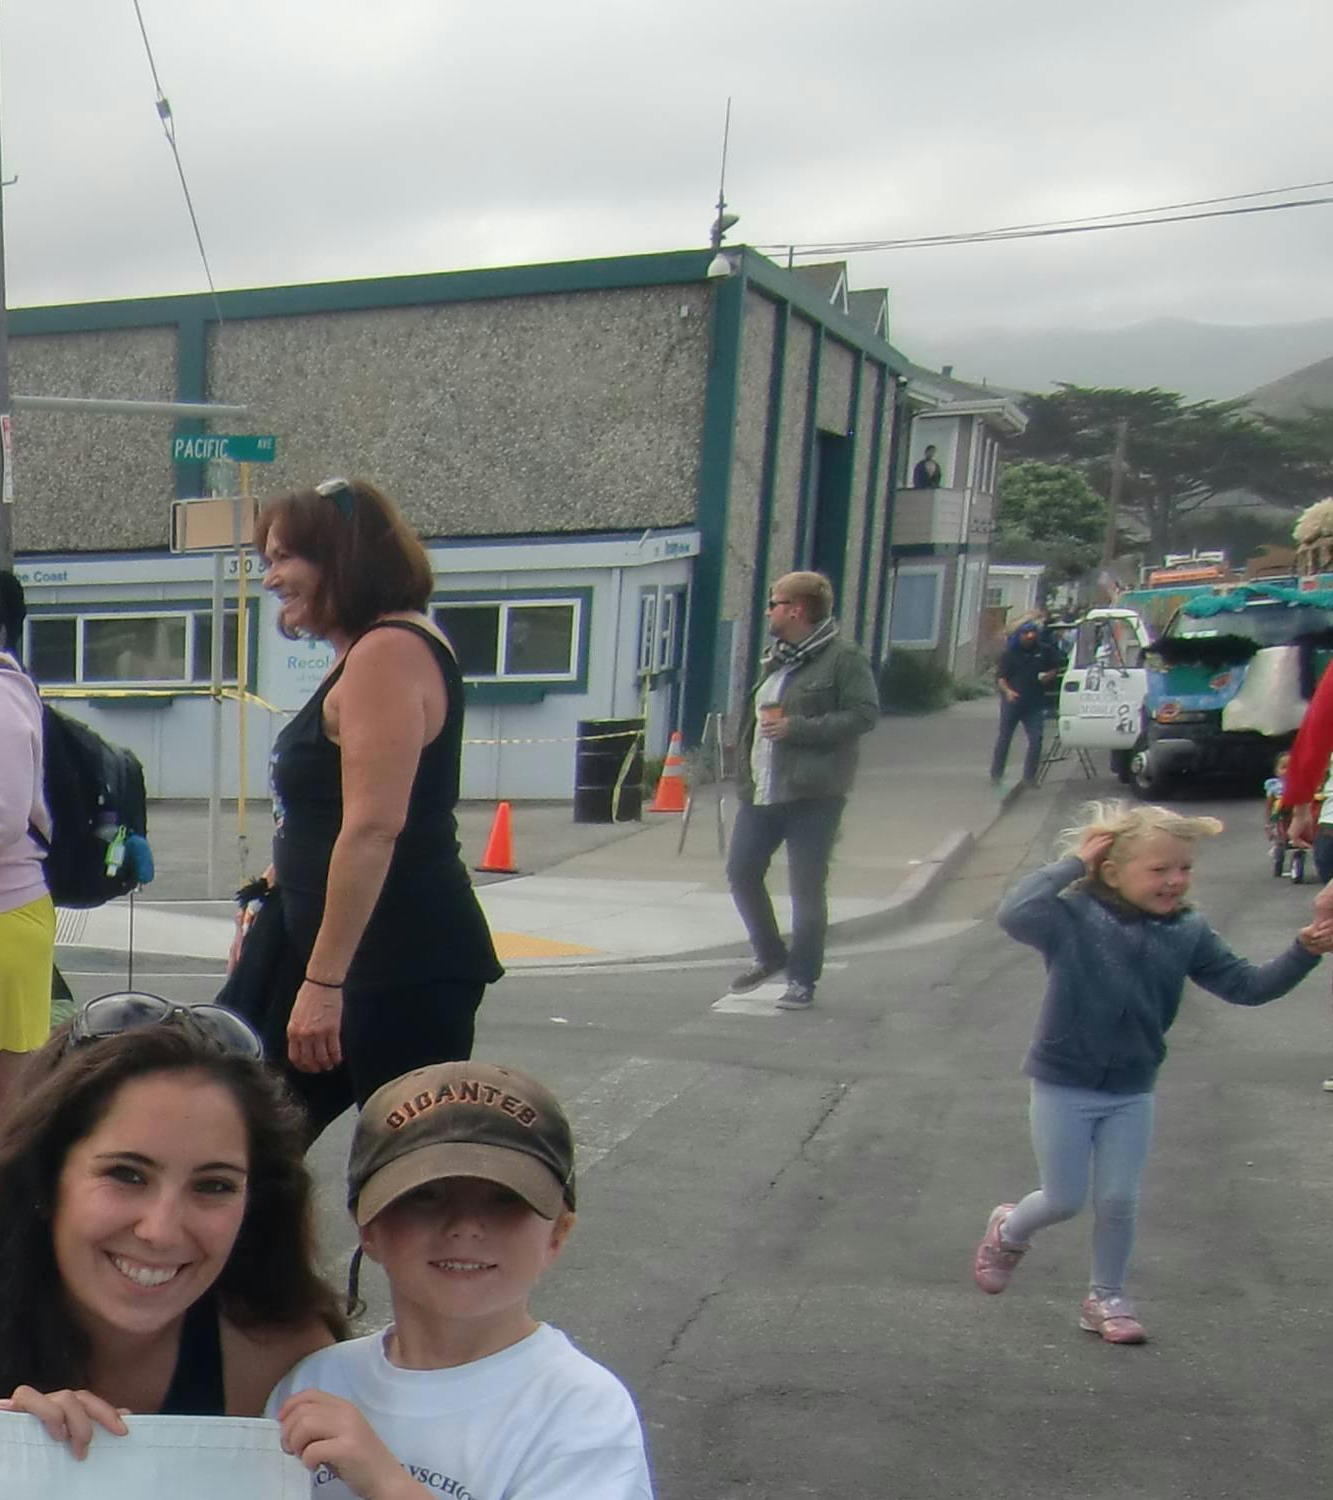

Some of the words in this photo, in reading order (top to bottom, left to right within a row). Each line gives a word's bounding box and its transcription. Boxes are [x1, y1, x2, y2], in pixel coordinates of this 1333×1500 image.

[174, 438, 229, 458] PACIFIC
[257, 438, 273, 449] AVE
[33, 570, 68, 583] Coast
[287, 655, 329, 669] Recol
[386, 1080, 537, 1129] GIGANTES
